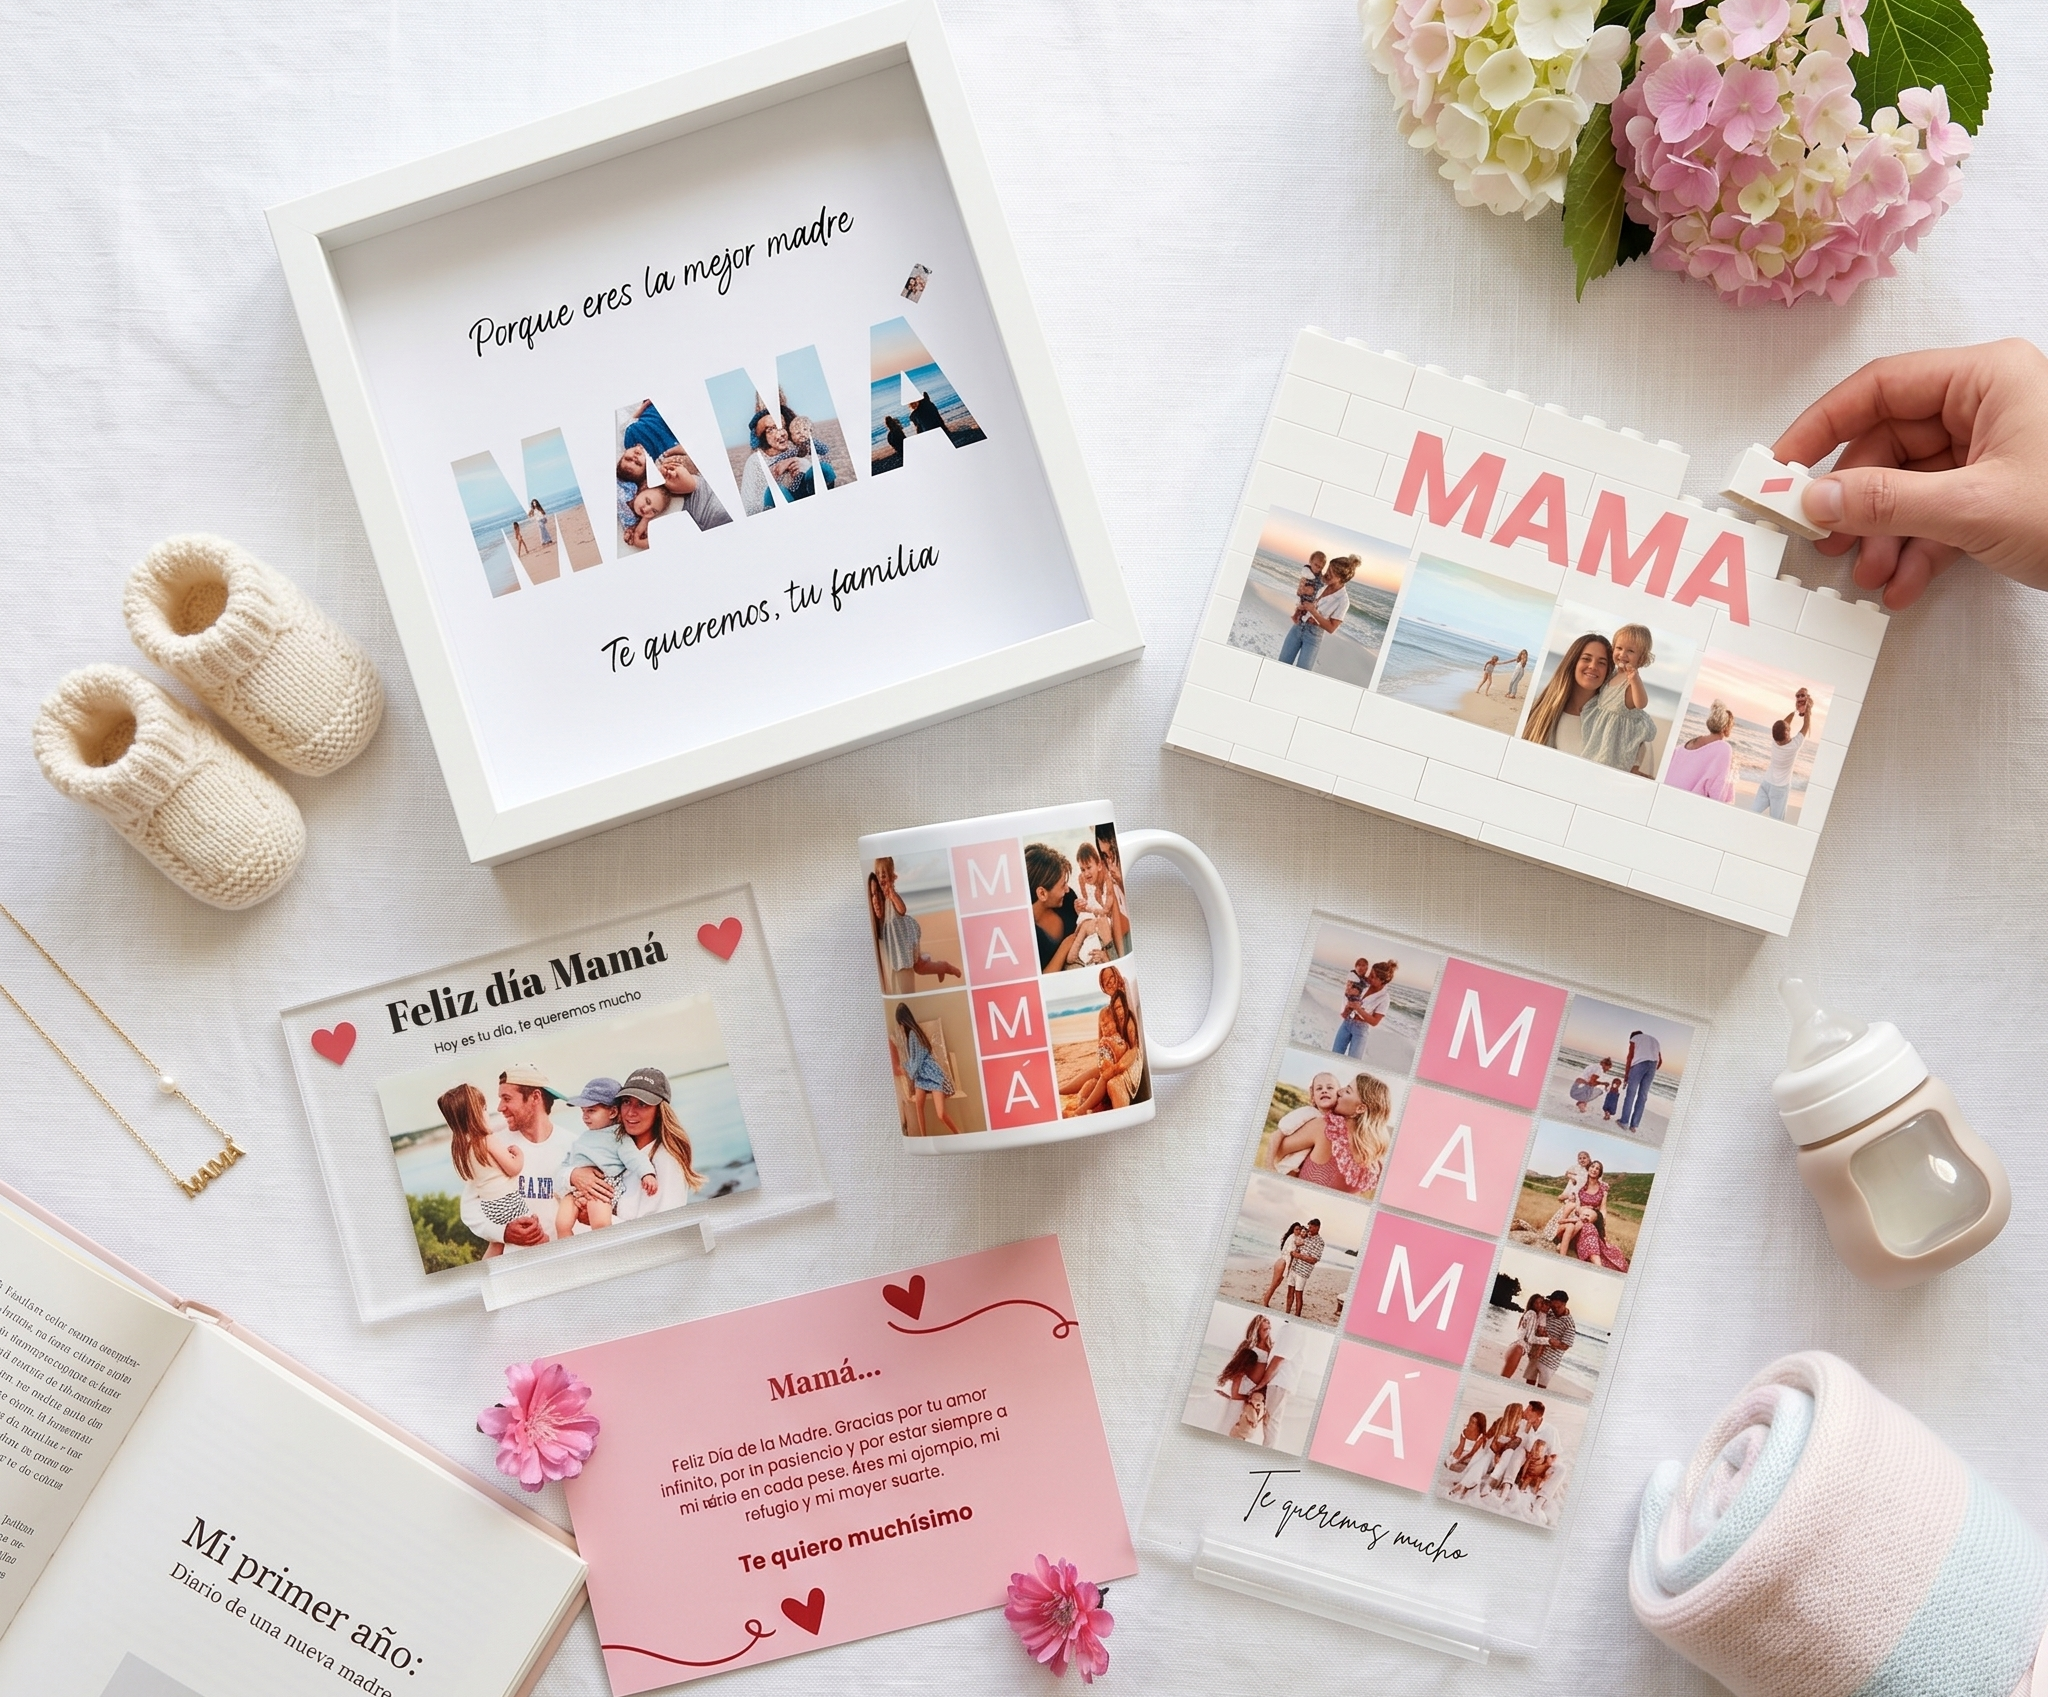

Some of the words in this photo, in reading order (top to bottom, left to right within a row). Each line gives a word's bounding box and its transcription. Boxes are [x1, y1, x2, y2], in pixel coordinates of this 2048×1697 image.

[469, 305, 574, 358] Porque
[583, 284, 632, 319] eres
[645, 266, 676, 299] la
[684, 244, 755, 296] mejor
[768, 206, 854, 258] madre
[601, 637, 636, 674] Te
[645, 601, 780, 669] queremos,
[784, 581, 823, 614] tu
[831, 545, 940, 613] familia
[386, 987, 479, 1035] Feliz
[486, 969, 547, 1008] día
[549, 932, 669, 991] Mamá
[435, 1041, 459, 1055] Hoy
[462, 1036, 476, 1048] es
[478, 1032, 491, 1043] tu
[519, 1021, 532, 1033] te
[534, 1004, 597, 1030] queremos
[599, 992, 642, 1011] mucho
[767, 1357, 881, 1402] Mamá...
[661, 1476, 718, 1498] infinito,
[721, 1468, 745, 1488] por
[768, 1444, 843, 1477] pasiencio
[846, 1442, 855, 1458] y
[860, 1435, 885, 1456] por
[889, 1425, 927, 1444] estar
[932, 1410, 993, 1434] siempre
[997, 1406, 1008, 1418] a
[672, 1454, 706, 1473] Feliz
[709, 1447, 734, 1464] Día
[738, 1442, 758, 1457] de
[760, 1438, 776, 1452] la
[779, 1427, 833, 1448] Madre.
[835, 1411, 894, 1434] Gracias
[898, 1404, 923, 1424] por
[927, 1399, 943, 1413] tu
[947, 1388, 987, 1408] amor
[680, 1498, 700, 1516] mi
[741, 1487, 761, 1501] en
[764, 1475, 804, 1496] cada
[888, 1449, 908, 1466] mi
[981, 1427, 1001, 1445] mi
[738, 1554, 767, 1573] Te
[772, 1537, 843, 1570] quiero
[848, 1506, 973, 1548] muchísimo
[746, 1499, 800, 1522] refugio
[802, 1496, 811, 1513] y
[816, 1488, 835, 1506] mi
[892, 1466, 945, 1488] suarte.
[1244, 1470, 1301, 1522] Te
[1274, 1500, 1390, 1551] queremos
[1393, 1522, 1468, 1563] mucho
[169, 1562, 222, 1603] Diario
[225, 1597, 247, 1618] de
[250, 1613, 281, 1640] una
[283, 1634, 335, 1671] nueva
[337, 1665, 392, 1697] madre
[182, 1516, 237, 1566] Mi
[228, 1554, 350, 1632] primer
[351, 1624, 423, 1676] año:
